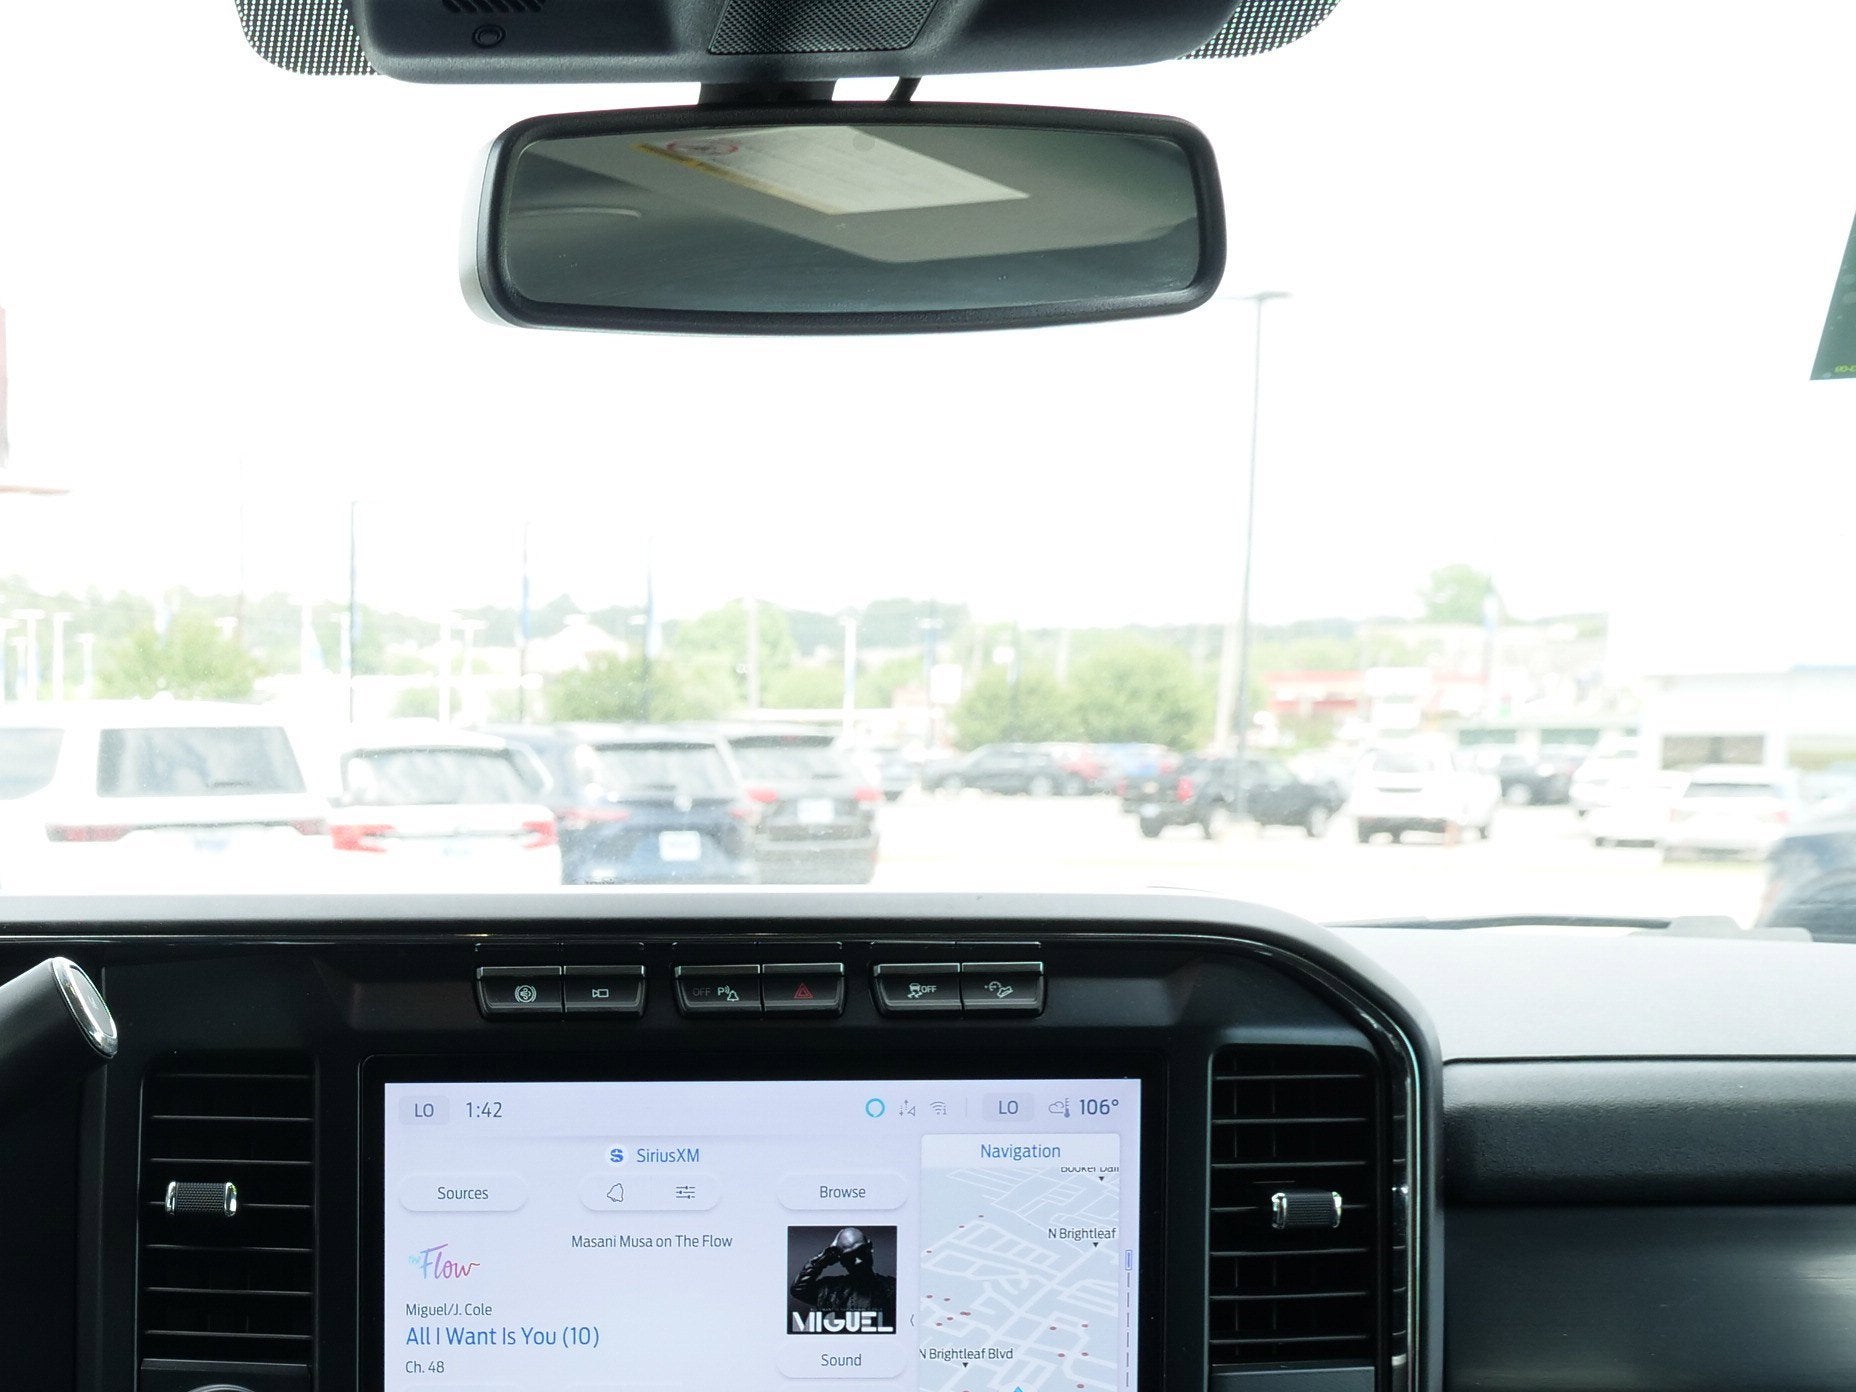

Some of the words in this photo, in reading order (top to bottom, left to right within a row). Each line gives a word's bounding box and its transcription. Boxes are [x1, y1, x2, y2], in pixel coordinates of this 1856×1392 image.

[920, 985, 938, 993] OFF
[414, 1103, 434, 1118] LO
[466, 1101, 503, 1118] 1:42
[998, 1100, 1019, 1115] LO
[1079, 1099, 1120, 1116] 106°
[637, 1148, 700, 1163] SiriusXM
[981, 1144, 1061, 1161] Navigation
[437, 1186, 489, 1201] Sources
[819, 1186, 866, 1200] Browse
[571, 1235, 617, 1248] Masani
[619, 1235, 653, 1248] Musa
[655, 1238, 672, 1248] on
[675, 1235, 699, 1248] The
[701, 1234, 733, 1248] Flow
[1048, 1228, 1058, 1240] N
[1059, 1227, 1117, 1242] Brightleaf
[420, 1243, 481, 1279] Flow
[405, 1303, 462, 1319] Miguel/J.
[464, 1303, 493, 1317] Cole
[792, 1311, 894, 1332] MIGUEL
[406, 1326, 431, 1346] All
[446, 1326, 497, 1346] Want
[502, 1326, 516, 1346] Is
[521, 1326, 557, 1346] You
[562, 1325, 600, 1349] (10)
[821, 1353, 862, 1367] Sound
[929, 1348, 985, 1361] Brightleaf
[988, 1348, 1014, 1360] Blvd
[405, 1360, 425, 1374] Ch.
[428, 1360, 445, 1374] 48
